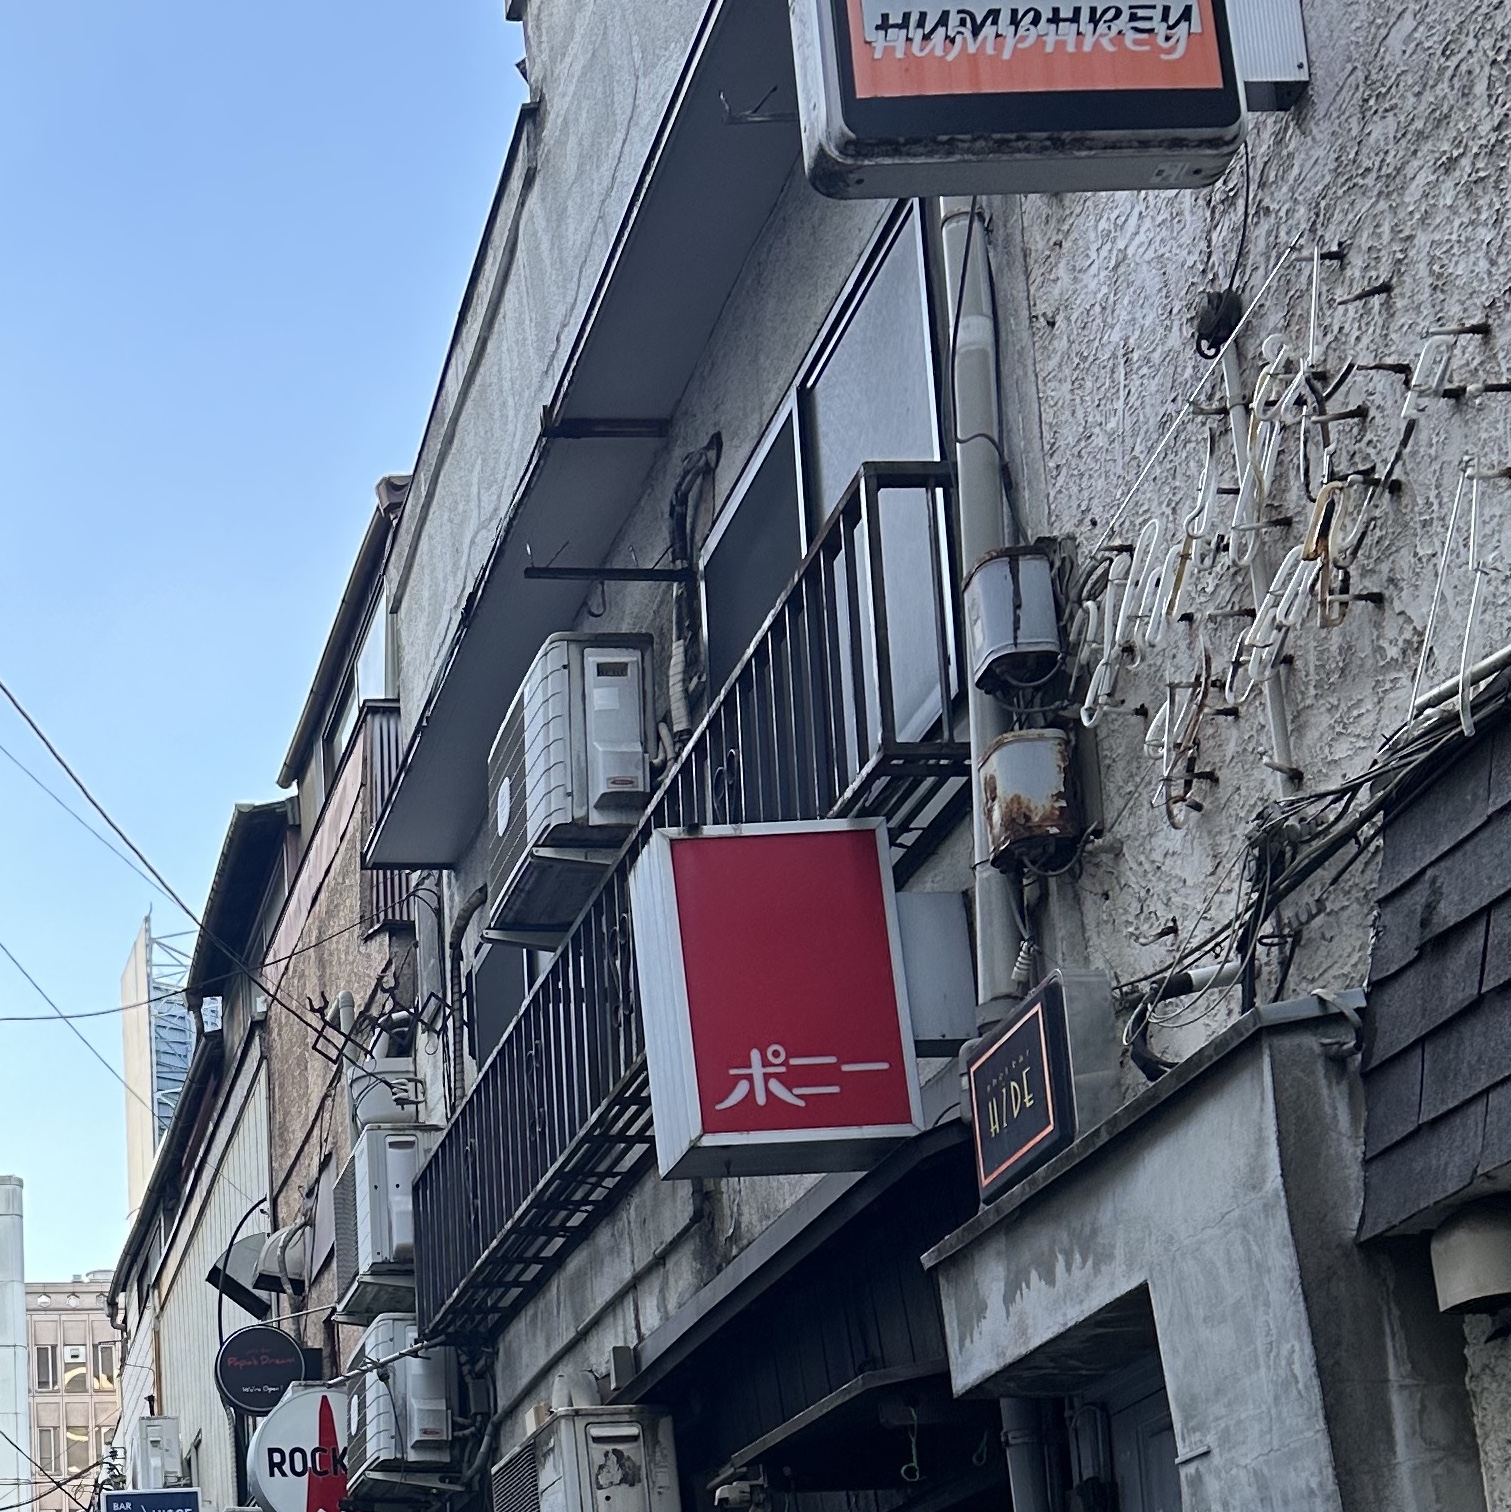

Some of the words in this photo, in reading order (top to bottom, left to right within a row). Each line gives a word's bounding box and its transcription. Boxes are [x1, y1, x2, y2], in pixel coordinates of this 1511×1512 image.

[715, 1044, 890, 1110] ポニー
[989, 1066, 1035, 1138] HIDE
[267, 1446, 348, 1478] ROCK
[112, 1501, 133, 1511] BAR
